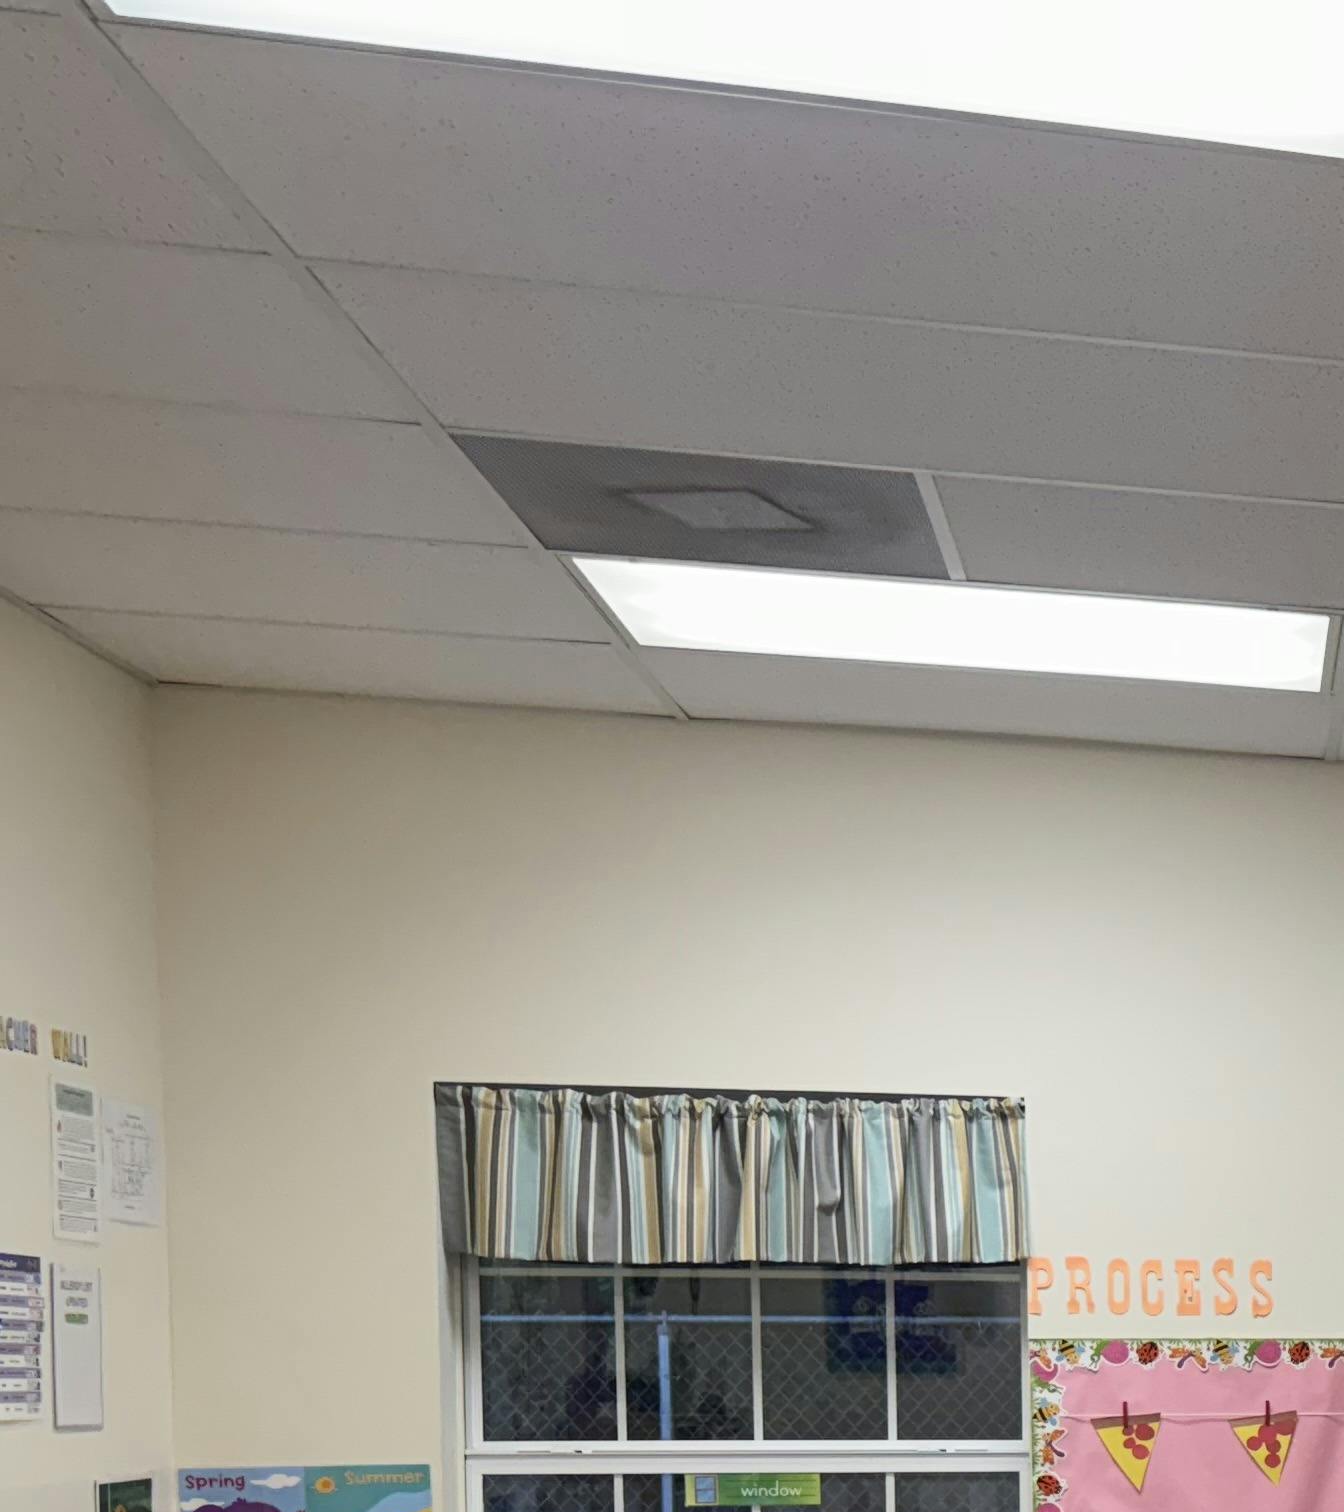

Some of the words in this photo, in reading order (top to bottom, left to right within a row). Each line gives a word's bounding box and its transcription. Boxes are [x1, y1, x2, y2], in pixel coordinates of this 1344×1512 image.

[1028, 1255, 1273, 1319] PROCESS
[185, 1474, 246, 1495] Spring
[344, 1471, 424, 1486] Summer
[740, 1480, 802, 1497] window
